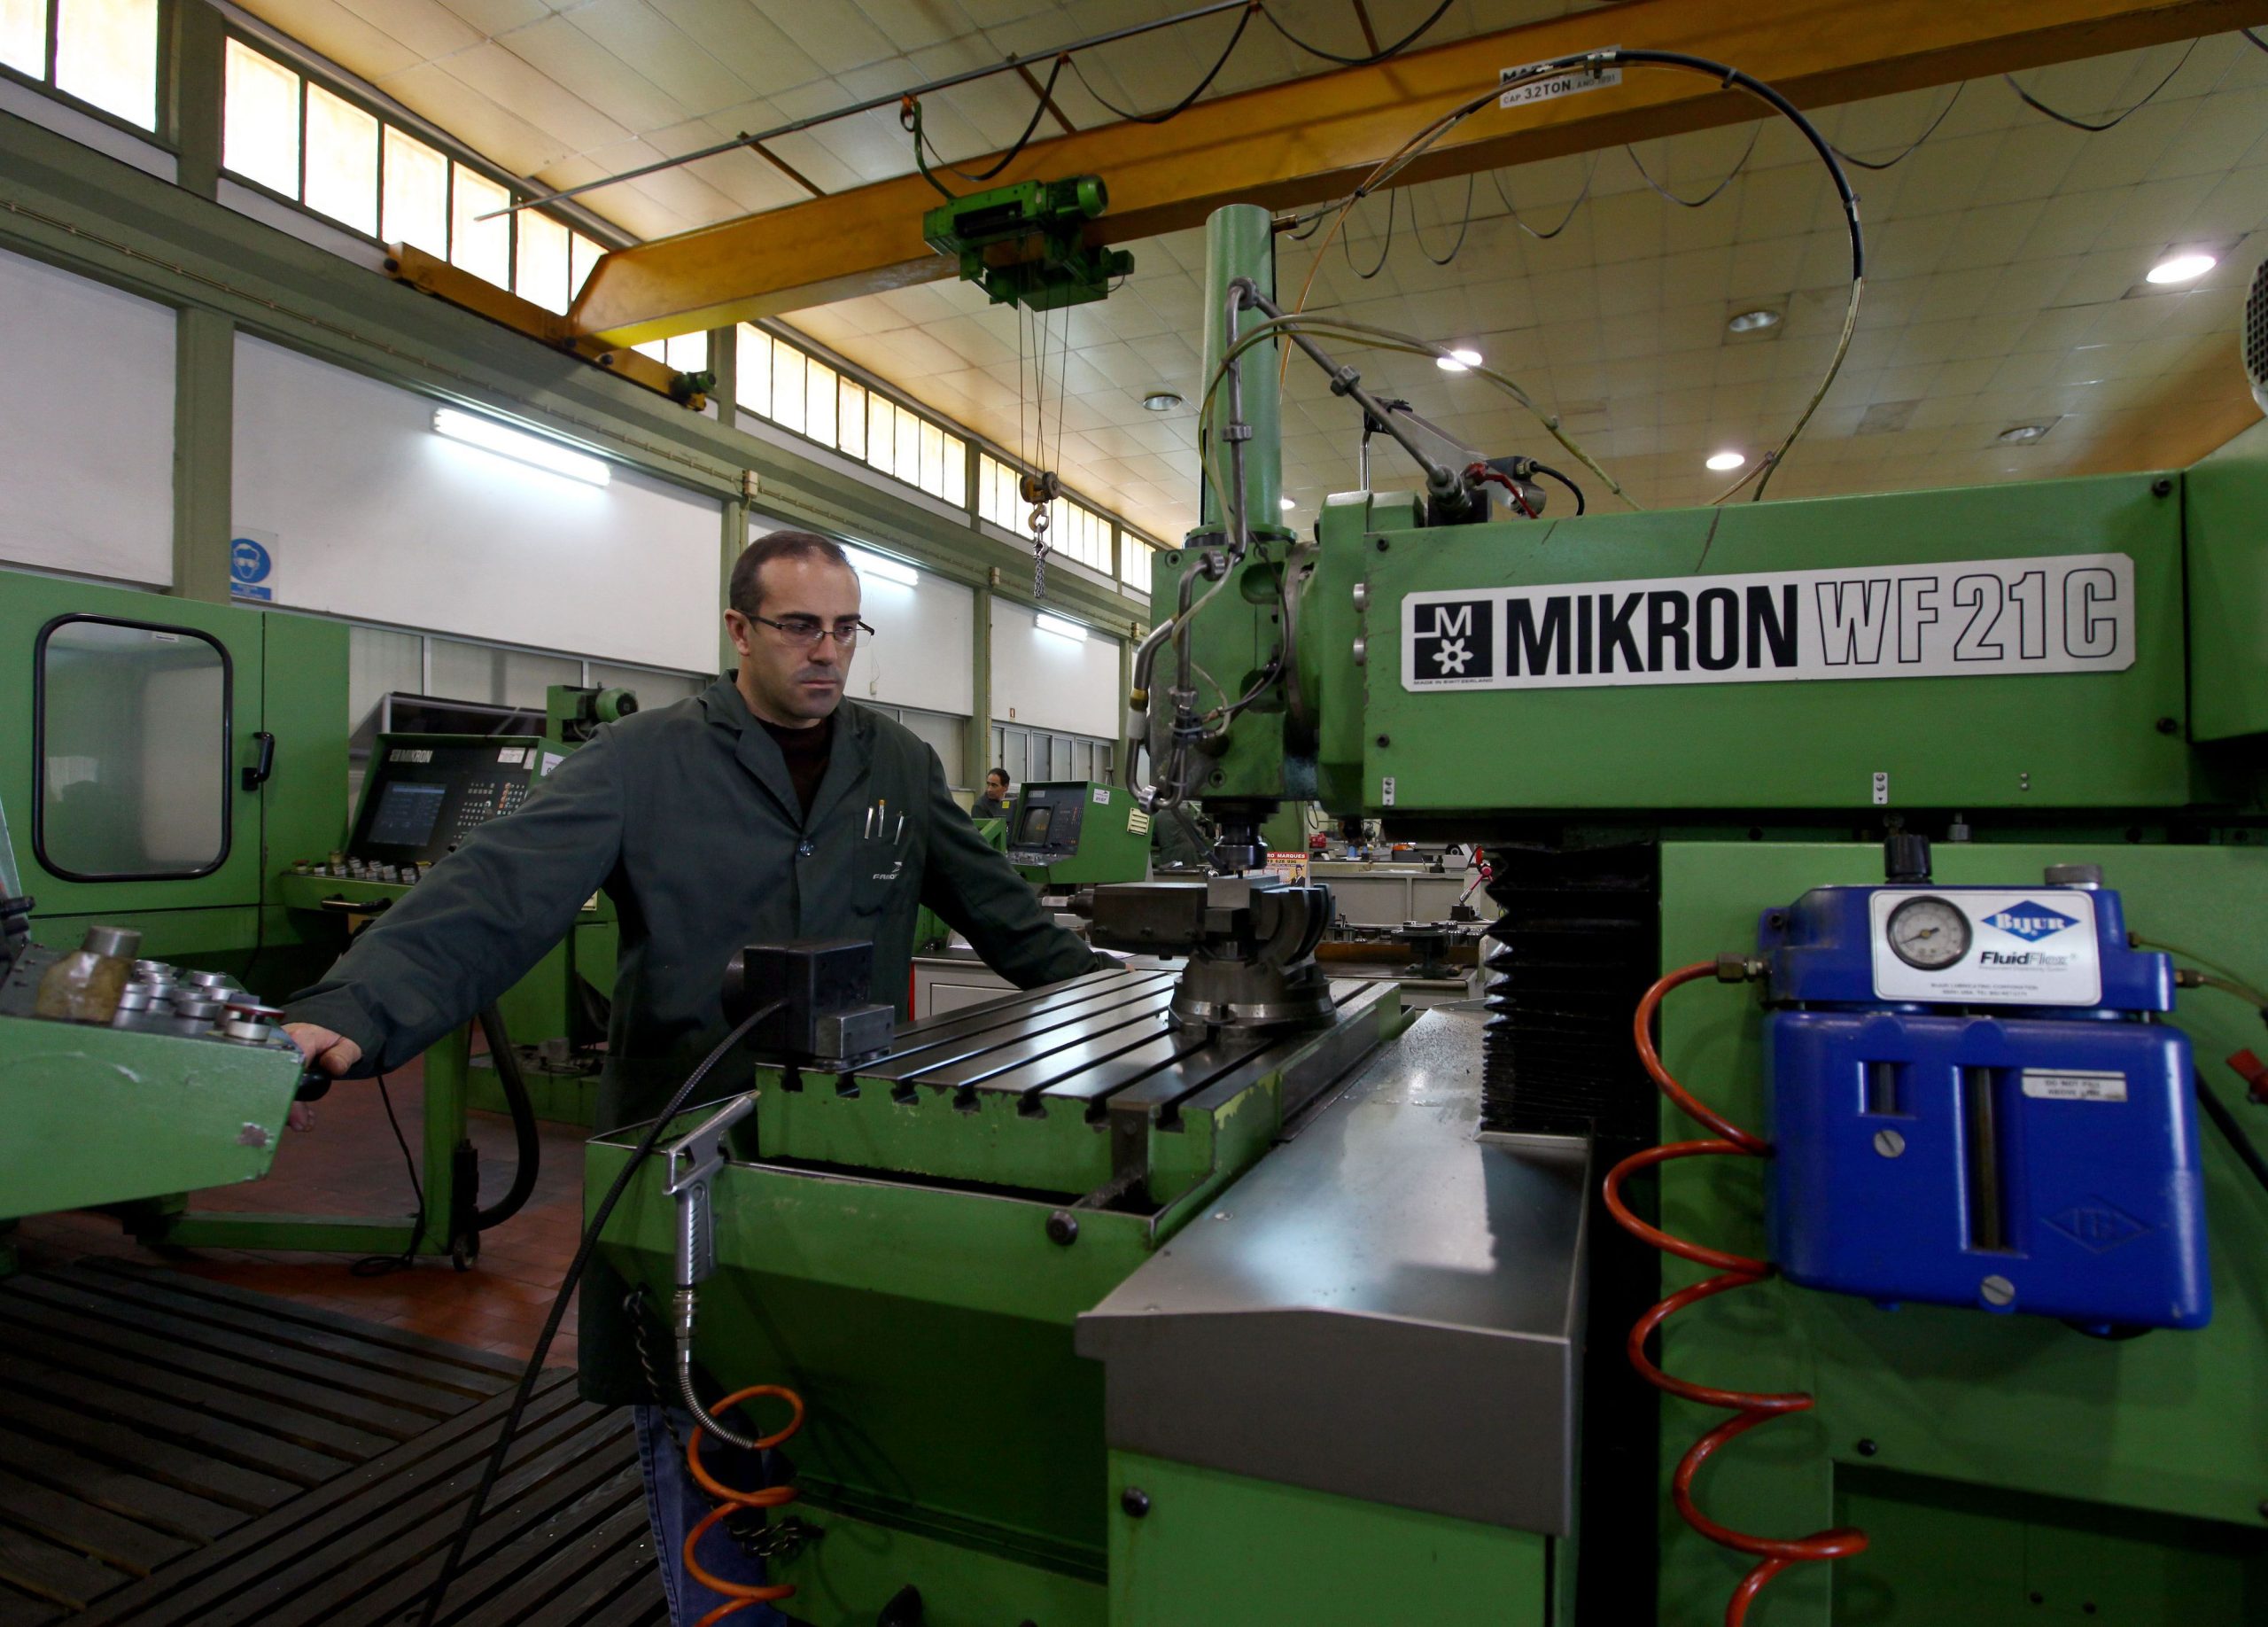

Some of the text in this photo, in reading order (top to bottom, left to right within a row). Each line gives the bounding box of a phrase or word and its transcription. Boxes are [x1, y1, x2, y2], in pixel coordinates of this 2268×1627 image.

[1506, 567, 2117, 677] MIKRON WF 21 C
